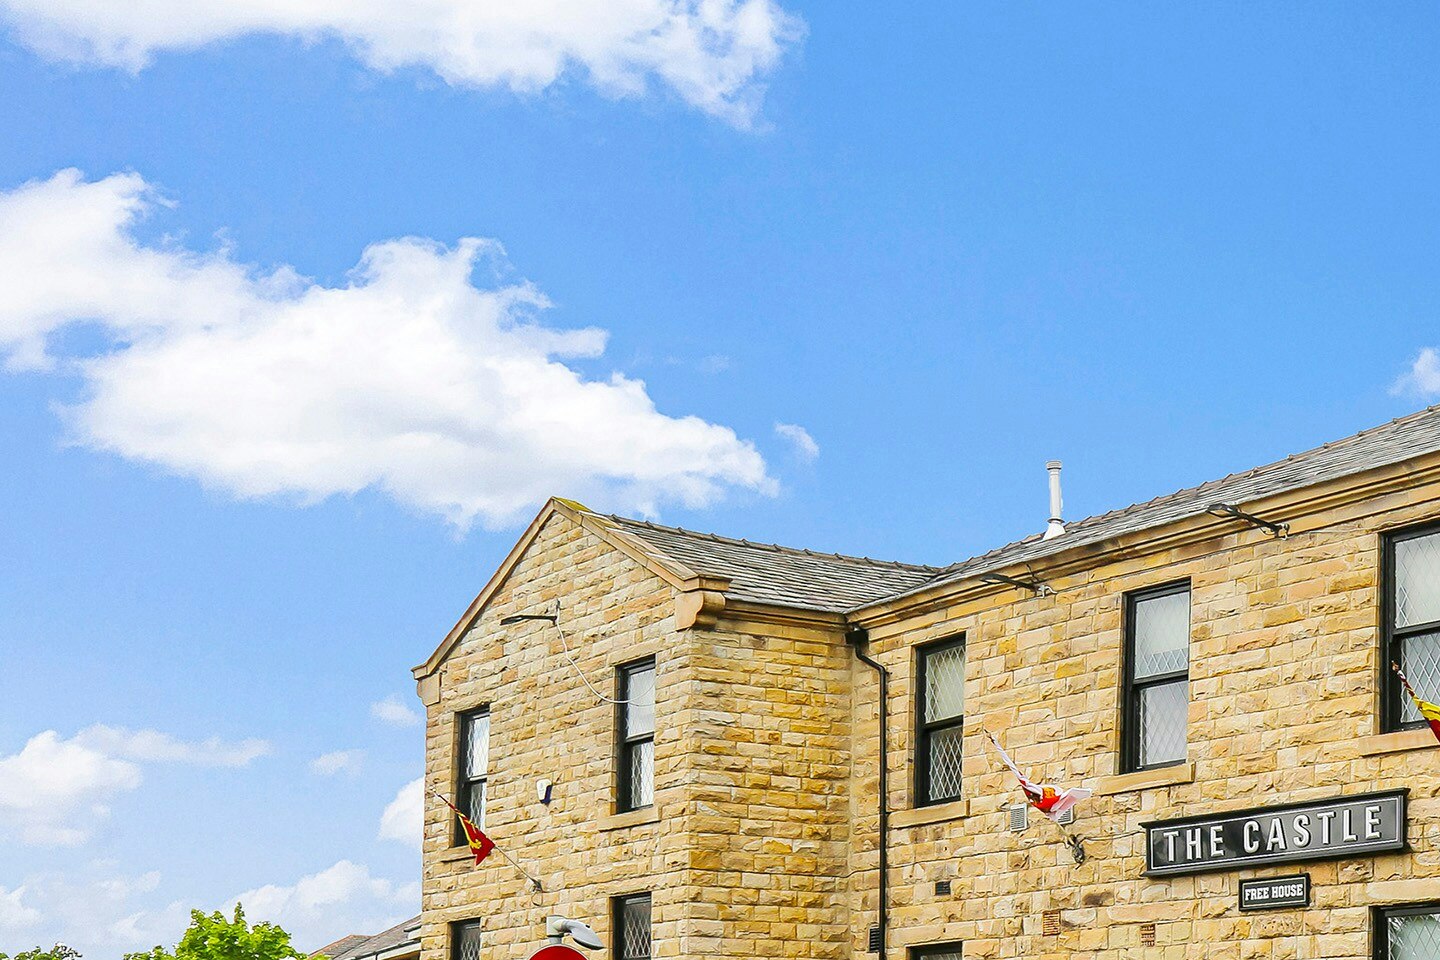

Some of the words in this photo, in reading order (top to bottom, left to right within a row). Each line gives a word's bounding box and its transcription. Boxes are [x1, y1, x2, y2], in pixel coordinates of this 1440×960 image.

[1163, 825, 1224, 862] THE
[1243, 805, 1382, 854] CASTLE
[1245, 887, 1270, 901] FREE
[1271, 883, 1304, 899] HOUSE
